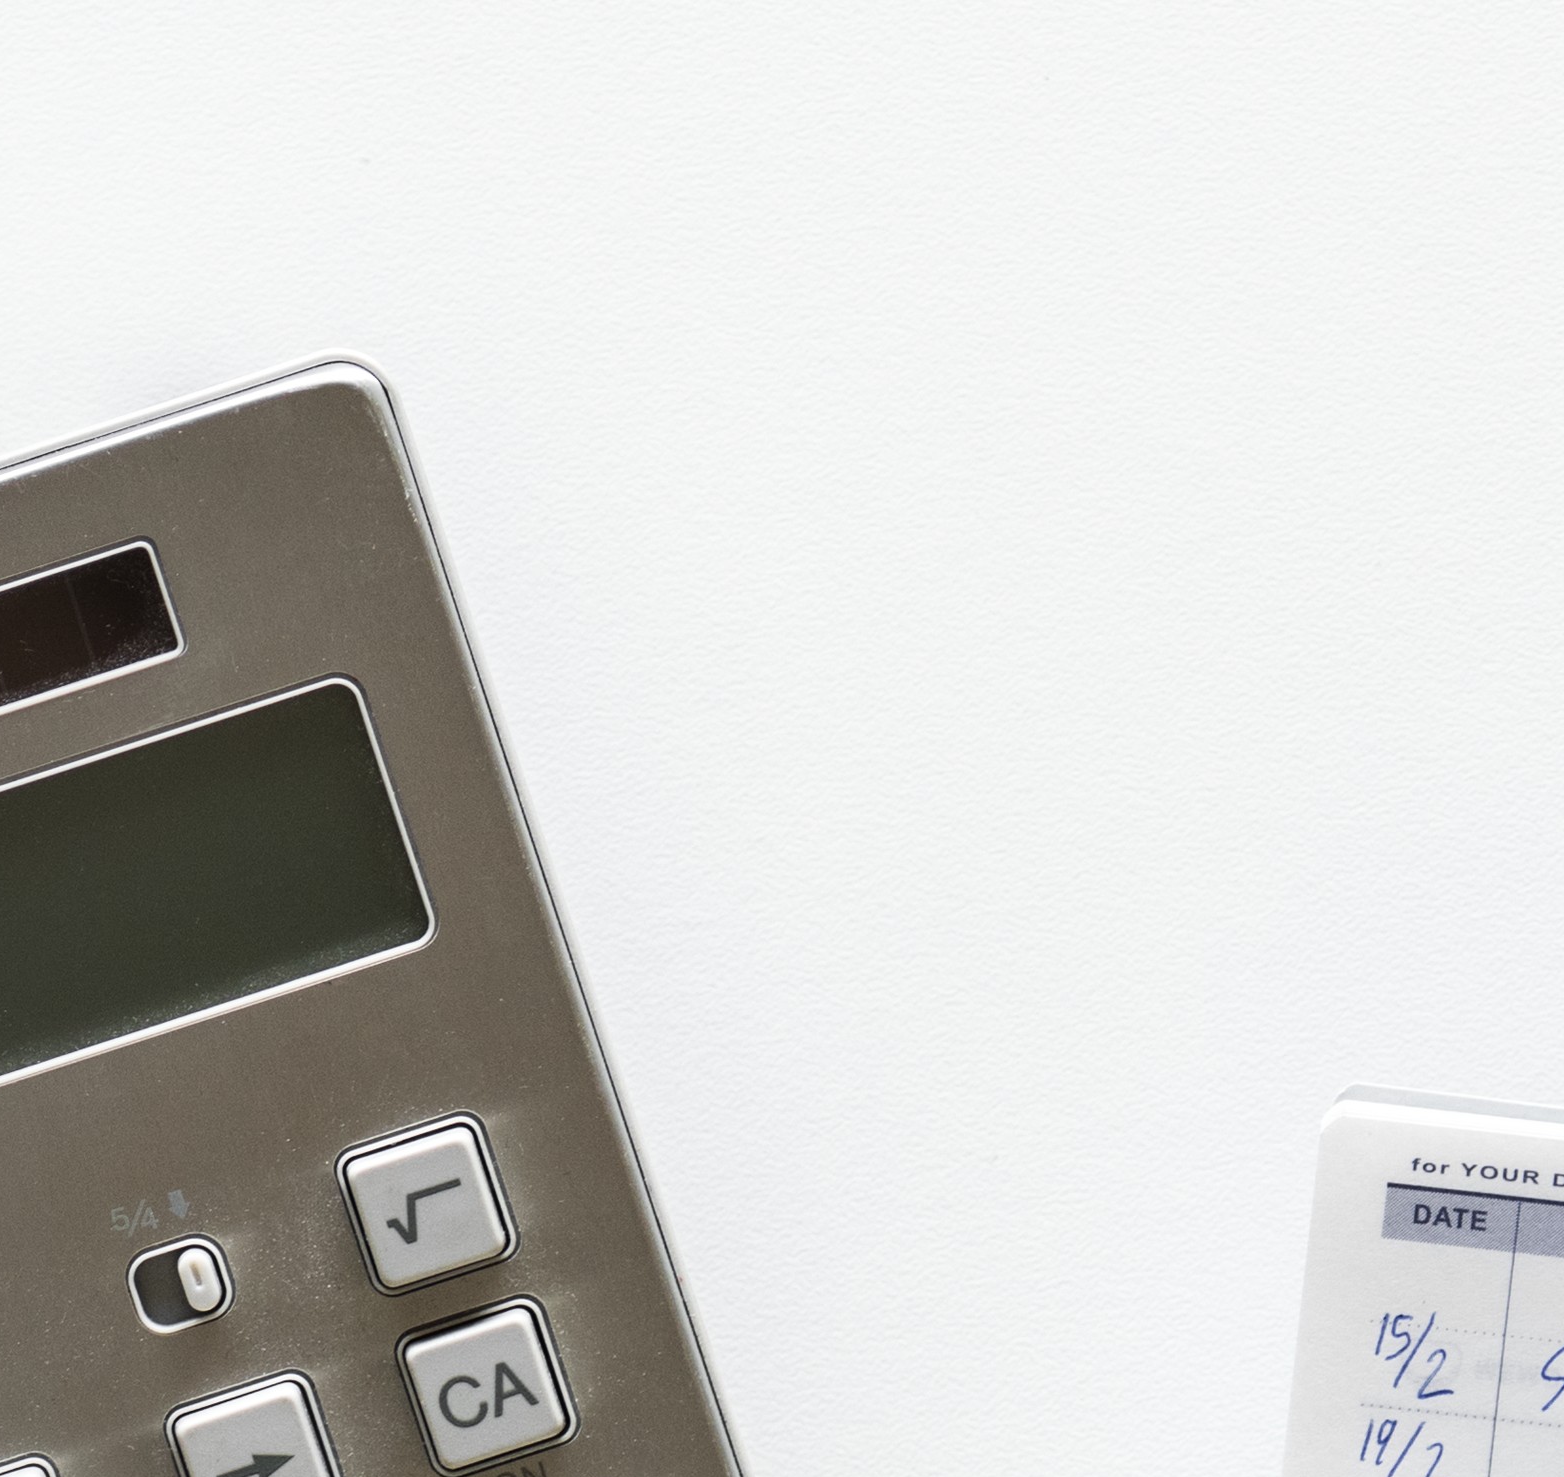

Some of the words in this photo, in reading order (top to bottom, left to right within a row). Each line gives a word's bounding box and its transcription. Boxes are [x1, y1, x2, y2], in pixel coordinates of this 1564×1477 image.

[1411, 1156, 1450, 1175] for
[1462, 1163, 1539, 1184] YOUR
[111, 1199, 159, 1238] 5/4
[1413, 1203, 1487, 1232] DATE
[1374, 1311, 1454, 1400] 15/2
[439, 1362, 539, 1428] CA
